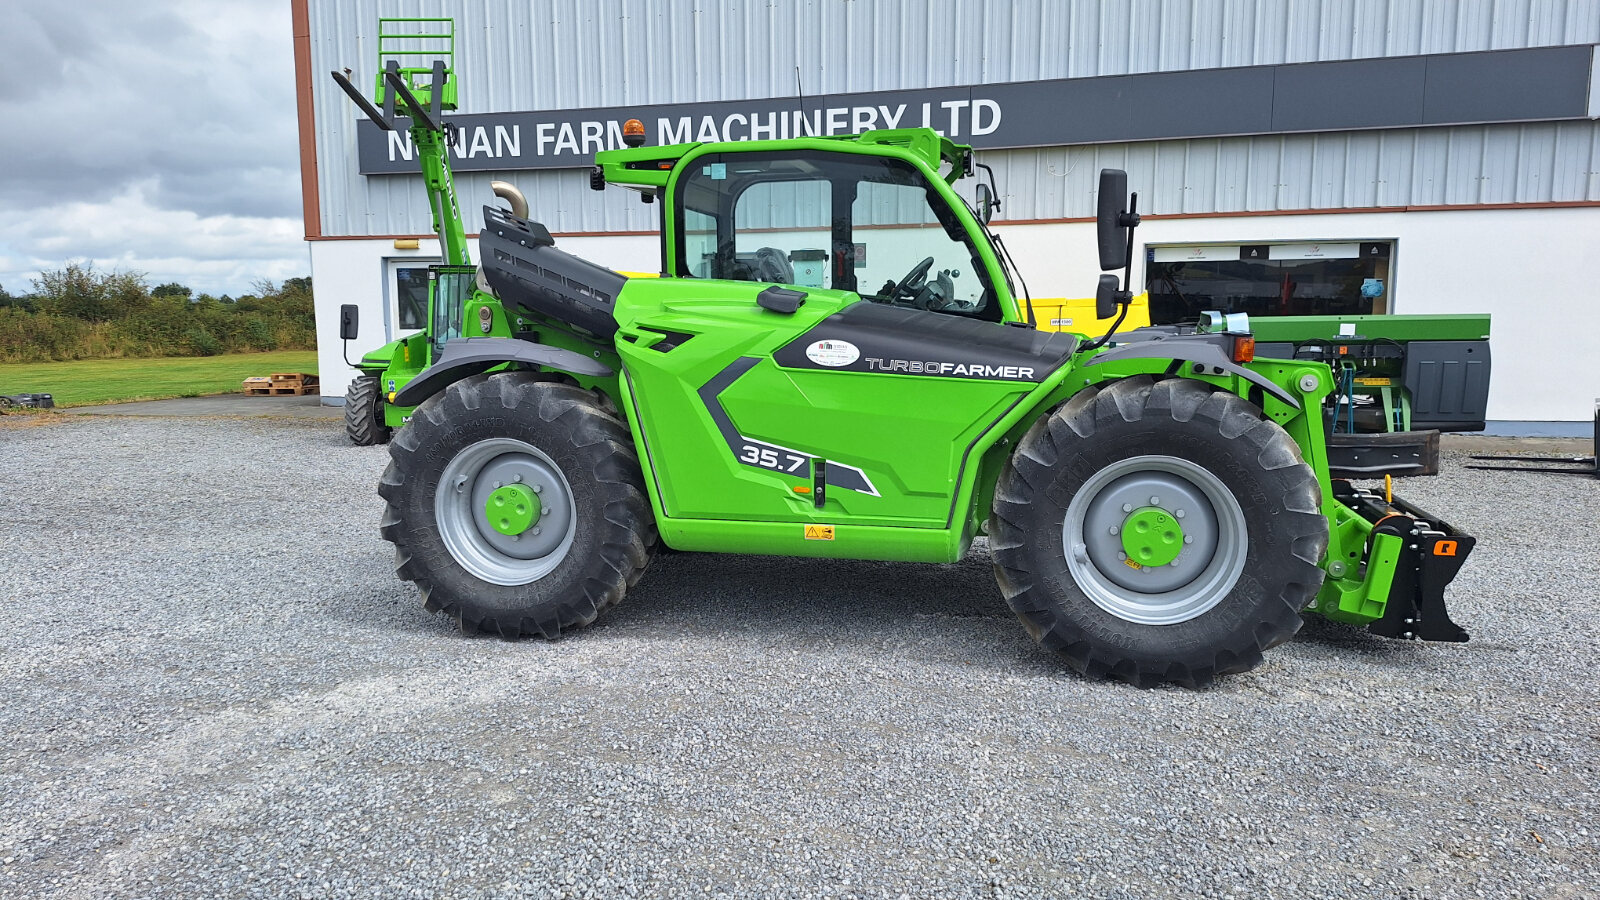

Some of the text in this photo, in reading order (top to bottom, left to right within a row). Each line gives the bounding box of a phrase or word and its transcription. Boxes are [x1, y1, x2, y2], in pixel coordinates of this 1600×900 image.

[388, 125, 520, 161] NNAN
[657, 104, 907, 145] MACHINERY
[922, 98, 1002, 137] LTD
[441, 154, 458, 220] MERLO
[865, 357, 1034, 379] TURBOFARMER
[740, 445, 805, 473] 35.7
